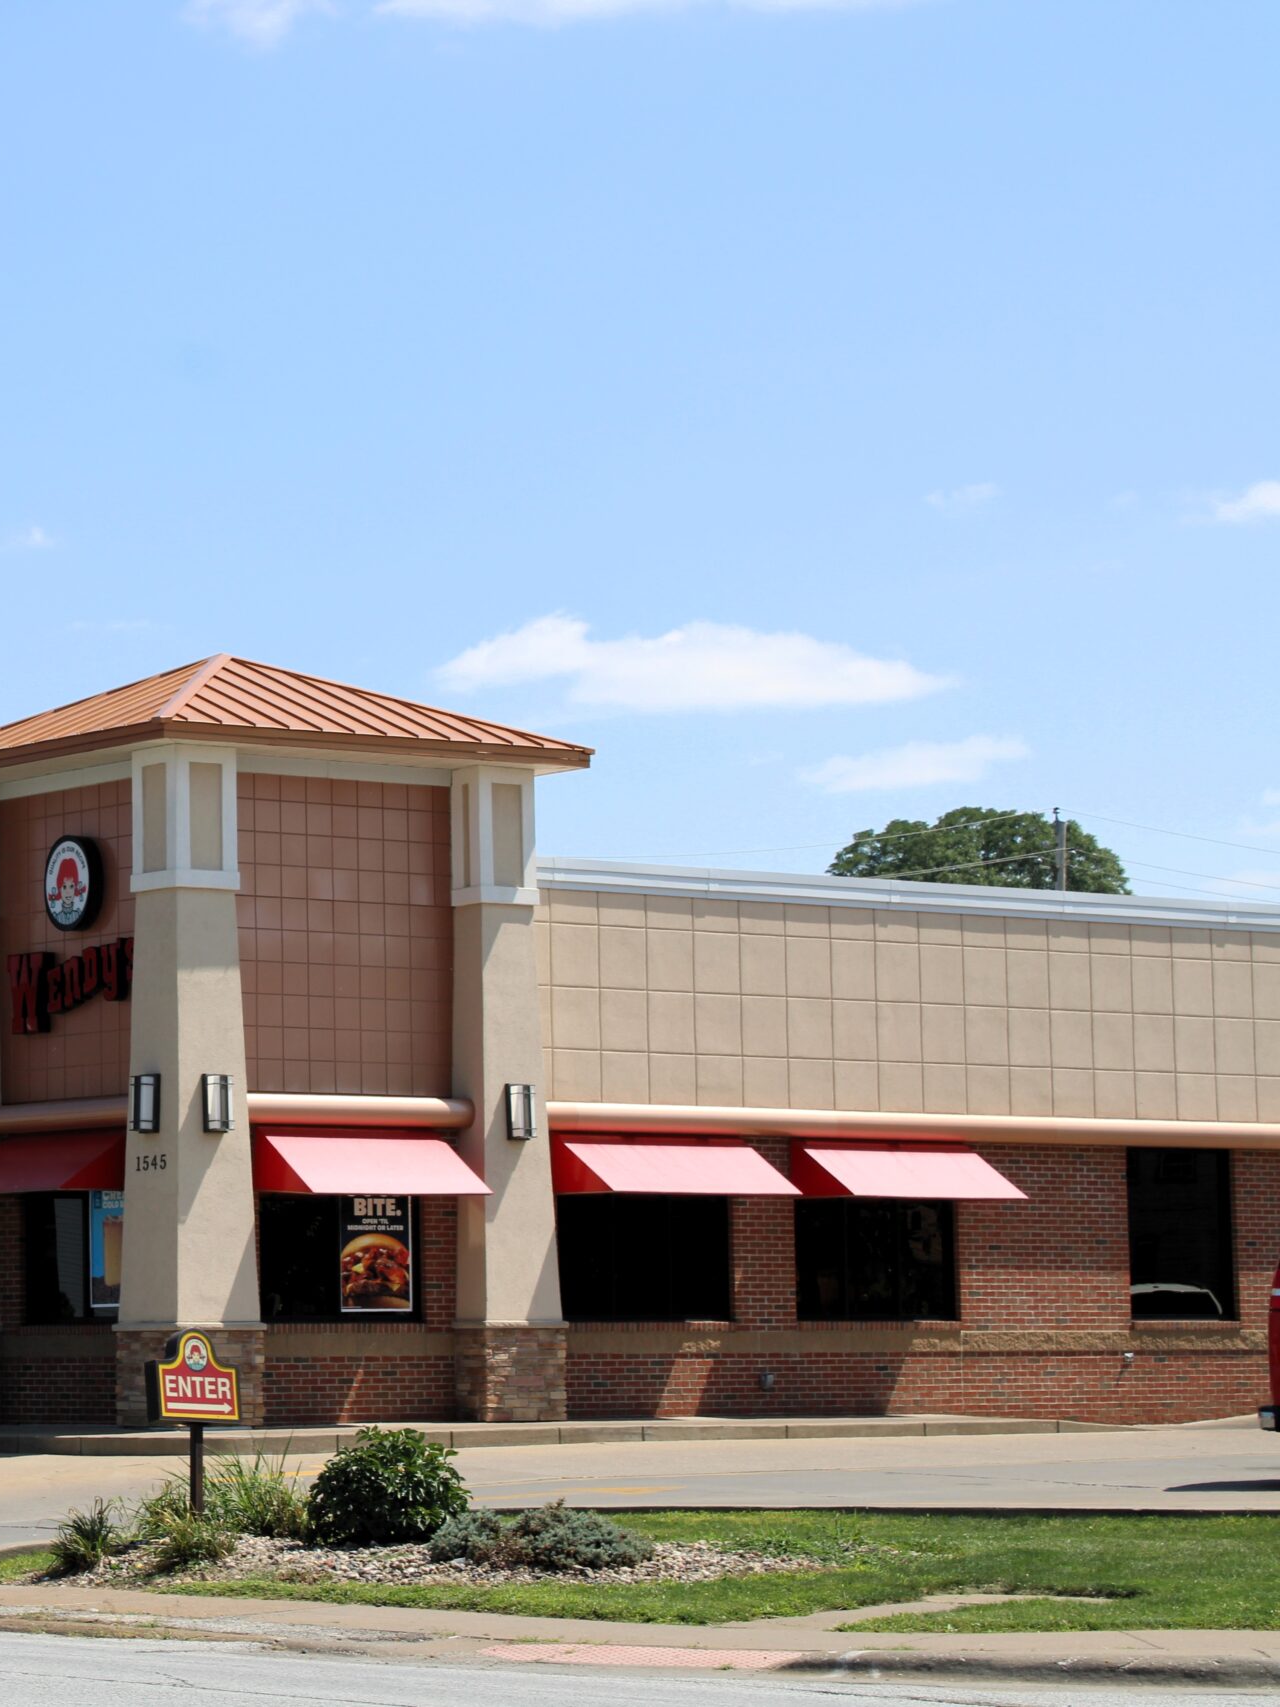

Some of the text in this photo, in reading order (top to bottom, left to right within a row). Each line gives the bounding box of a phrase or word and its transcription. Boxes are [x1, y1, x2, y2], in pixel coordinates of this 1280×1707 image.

[136, 1154, 167, 1171] 1545
[353, 1198, 402, 1216] BITE.
[165, 1375, 231, 1399] ENTER
